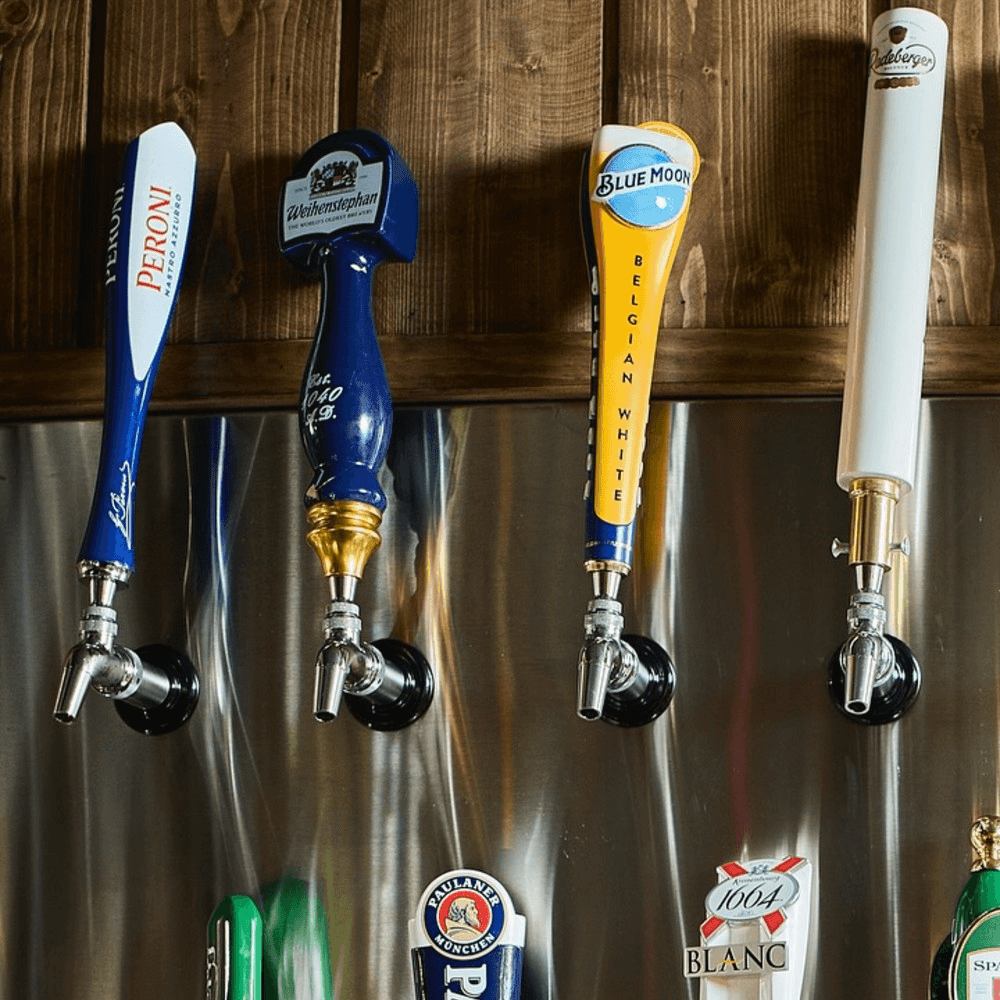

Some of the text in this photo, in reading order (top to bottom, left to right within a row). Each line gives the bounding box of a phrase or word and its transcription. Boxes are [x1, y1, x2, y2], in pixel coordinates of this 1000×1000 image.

[595, 166, 691, 198] BLUE MOON
[286, 191, 379, 222] Weihenstephan
[135, 185, 172, 293] PERONI
[165, 192, 182, 298] NASTRO AZZURRO
[621, 254, 644, 385] BELGIAN
[613, 407, 632, 502] WHITE
[427, 877, 501, 909] PAULANER
[716, 881, 784, 912] 1664
[433, 932, 496, 955] MÜNCHEN
[686, 943, 787, 975] BLANC
